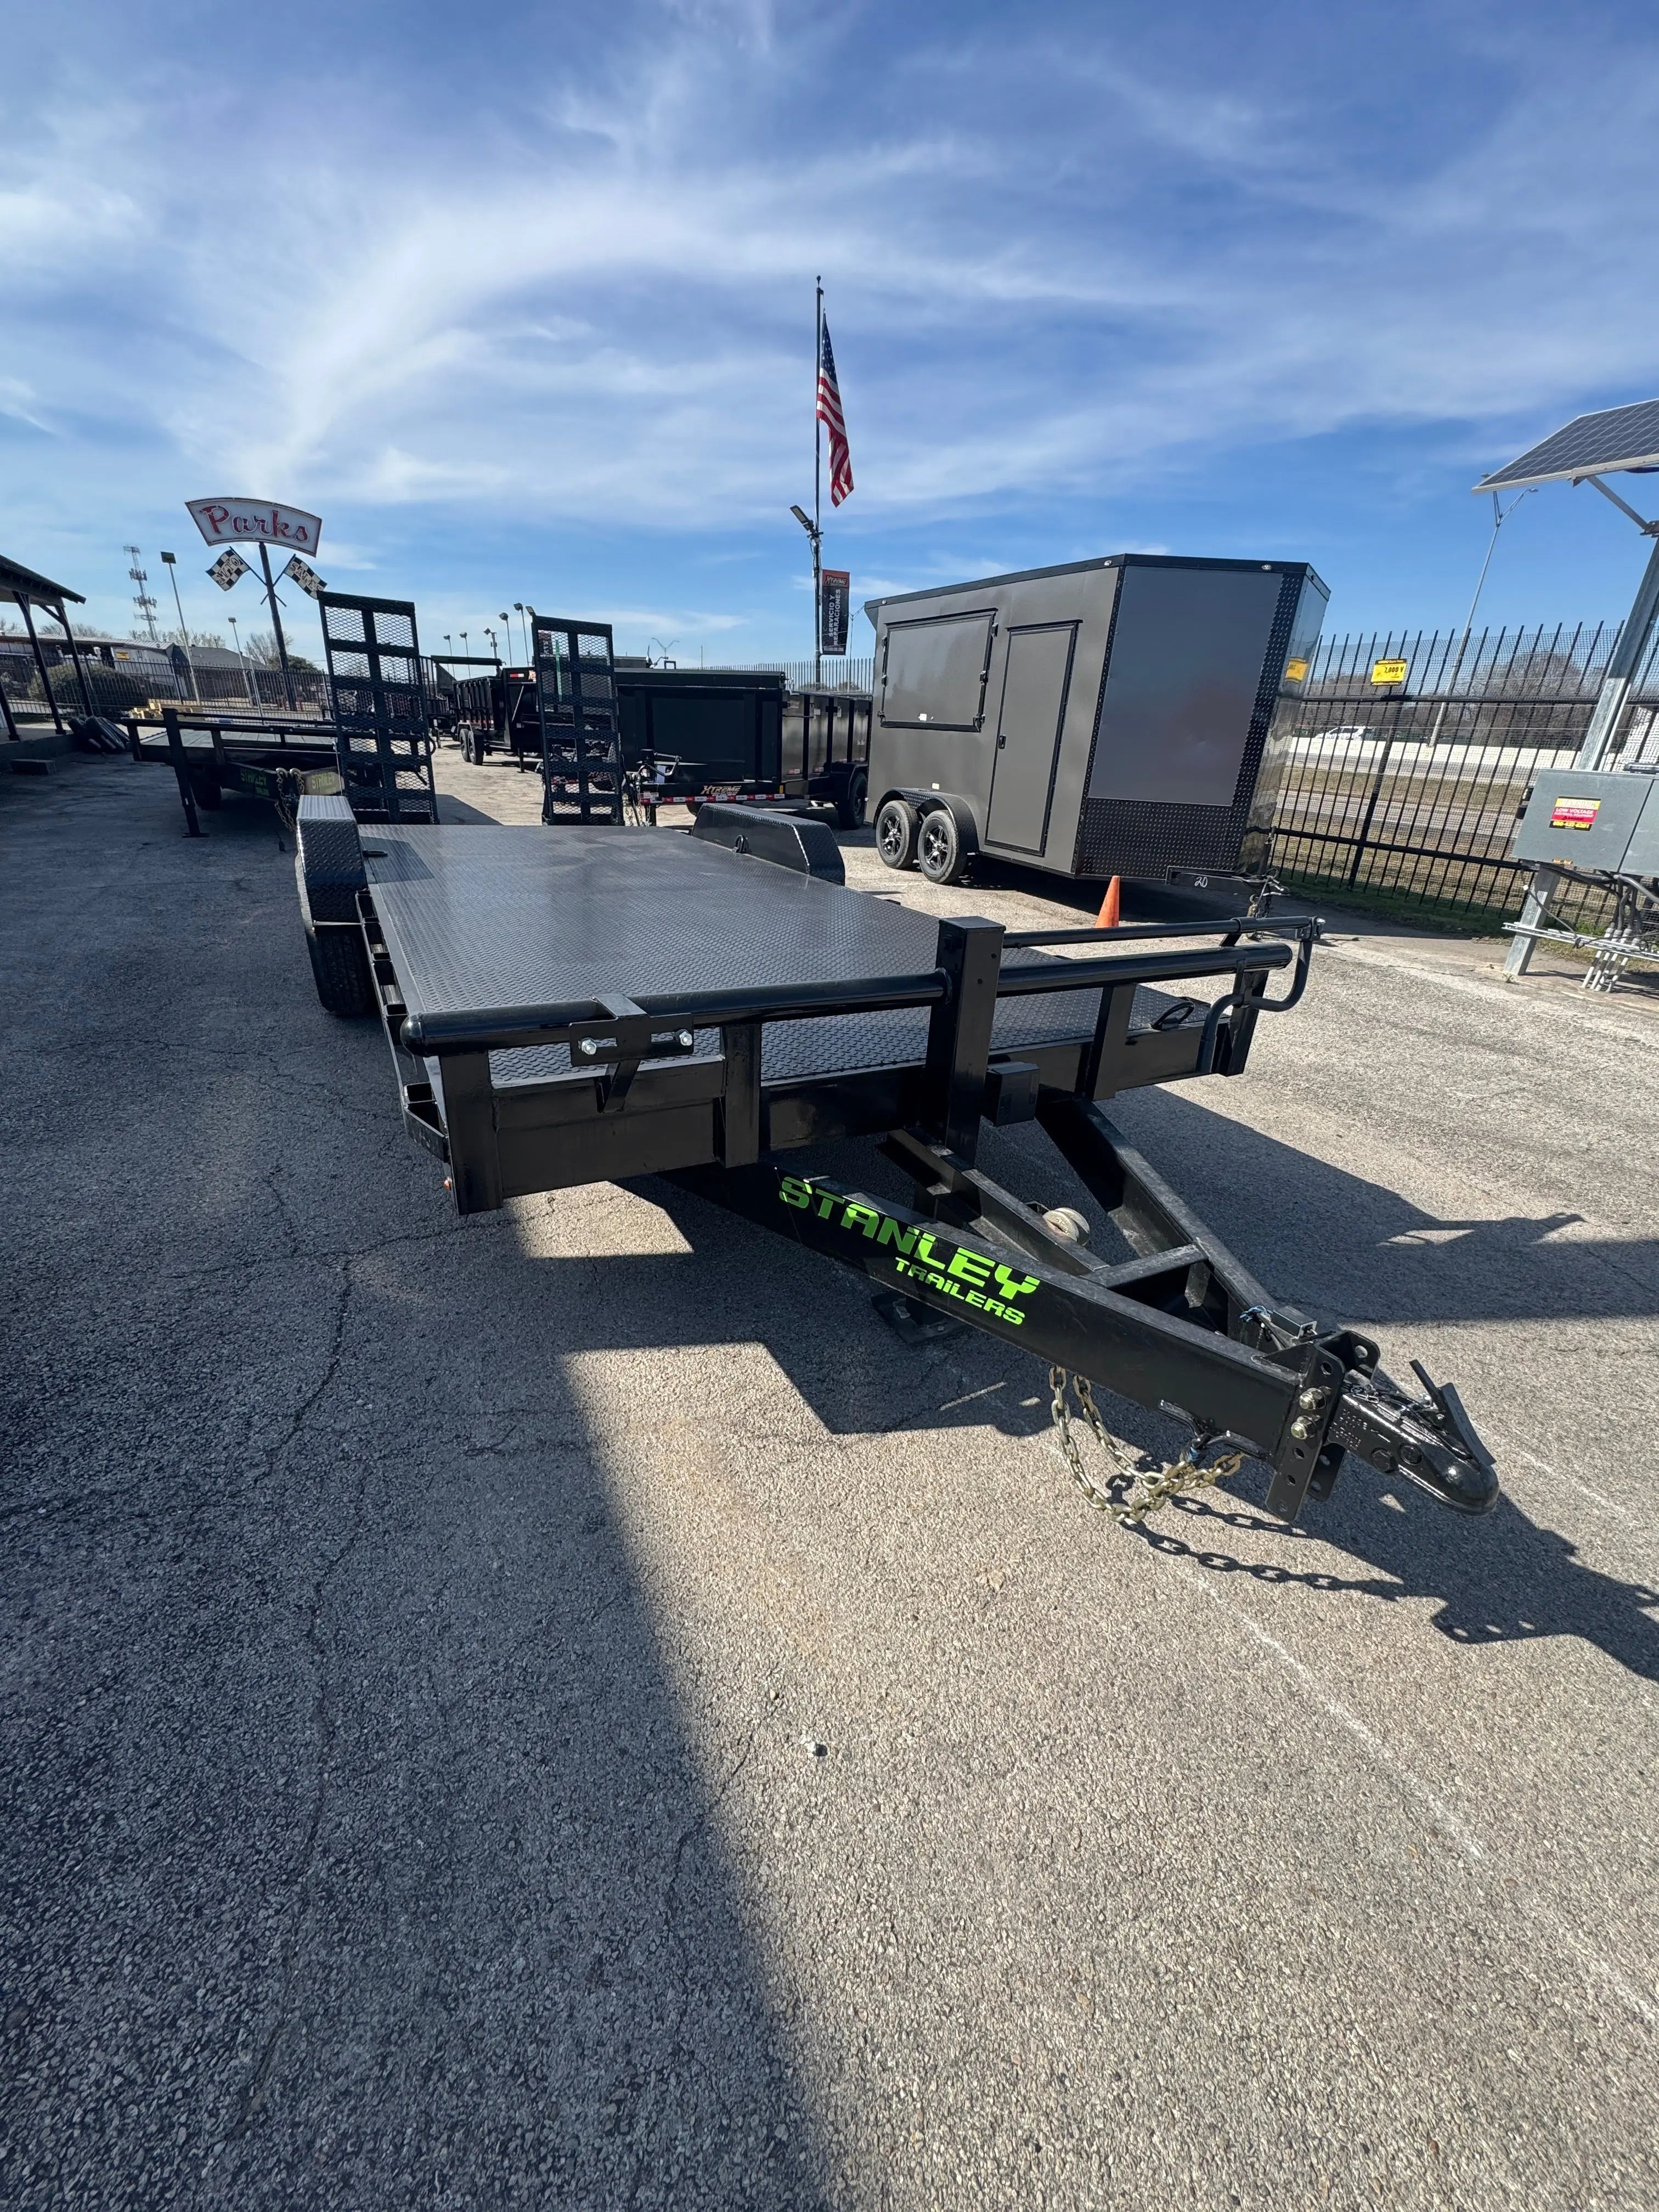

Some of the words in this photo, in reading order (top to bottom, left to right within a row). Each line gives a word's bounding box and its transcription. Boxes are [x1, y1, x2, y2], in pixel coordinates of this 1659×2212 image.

[198, 505, 309, 542] Parks
[215, 556, 241, 585] AUTO
[290, 561, 324, 592] SALES
[826, 575, 847, 585] XTREME
[311, 771, 335, 790] STANLEY
[701, 785, 742, 795] XTREME
[1194, 877, 1207, 888] 20
[779, 1176, 1040, 1300] STANLEY
[895, 1256, 1025, 1325] TRAILERS
